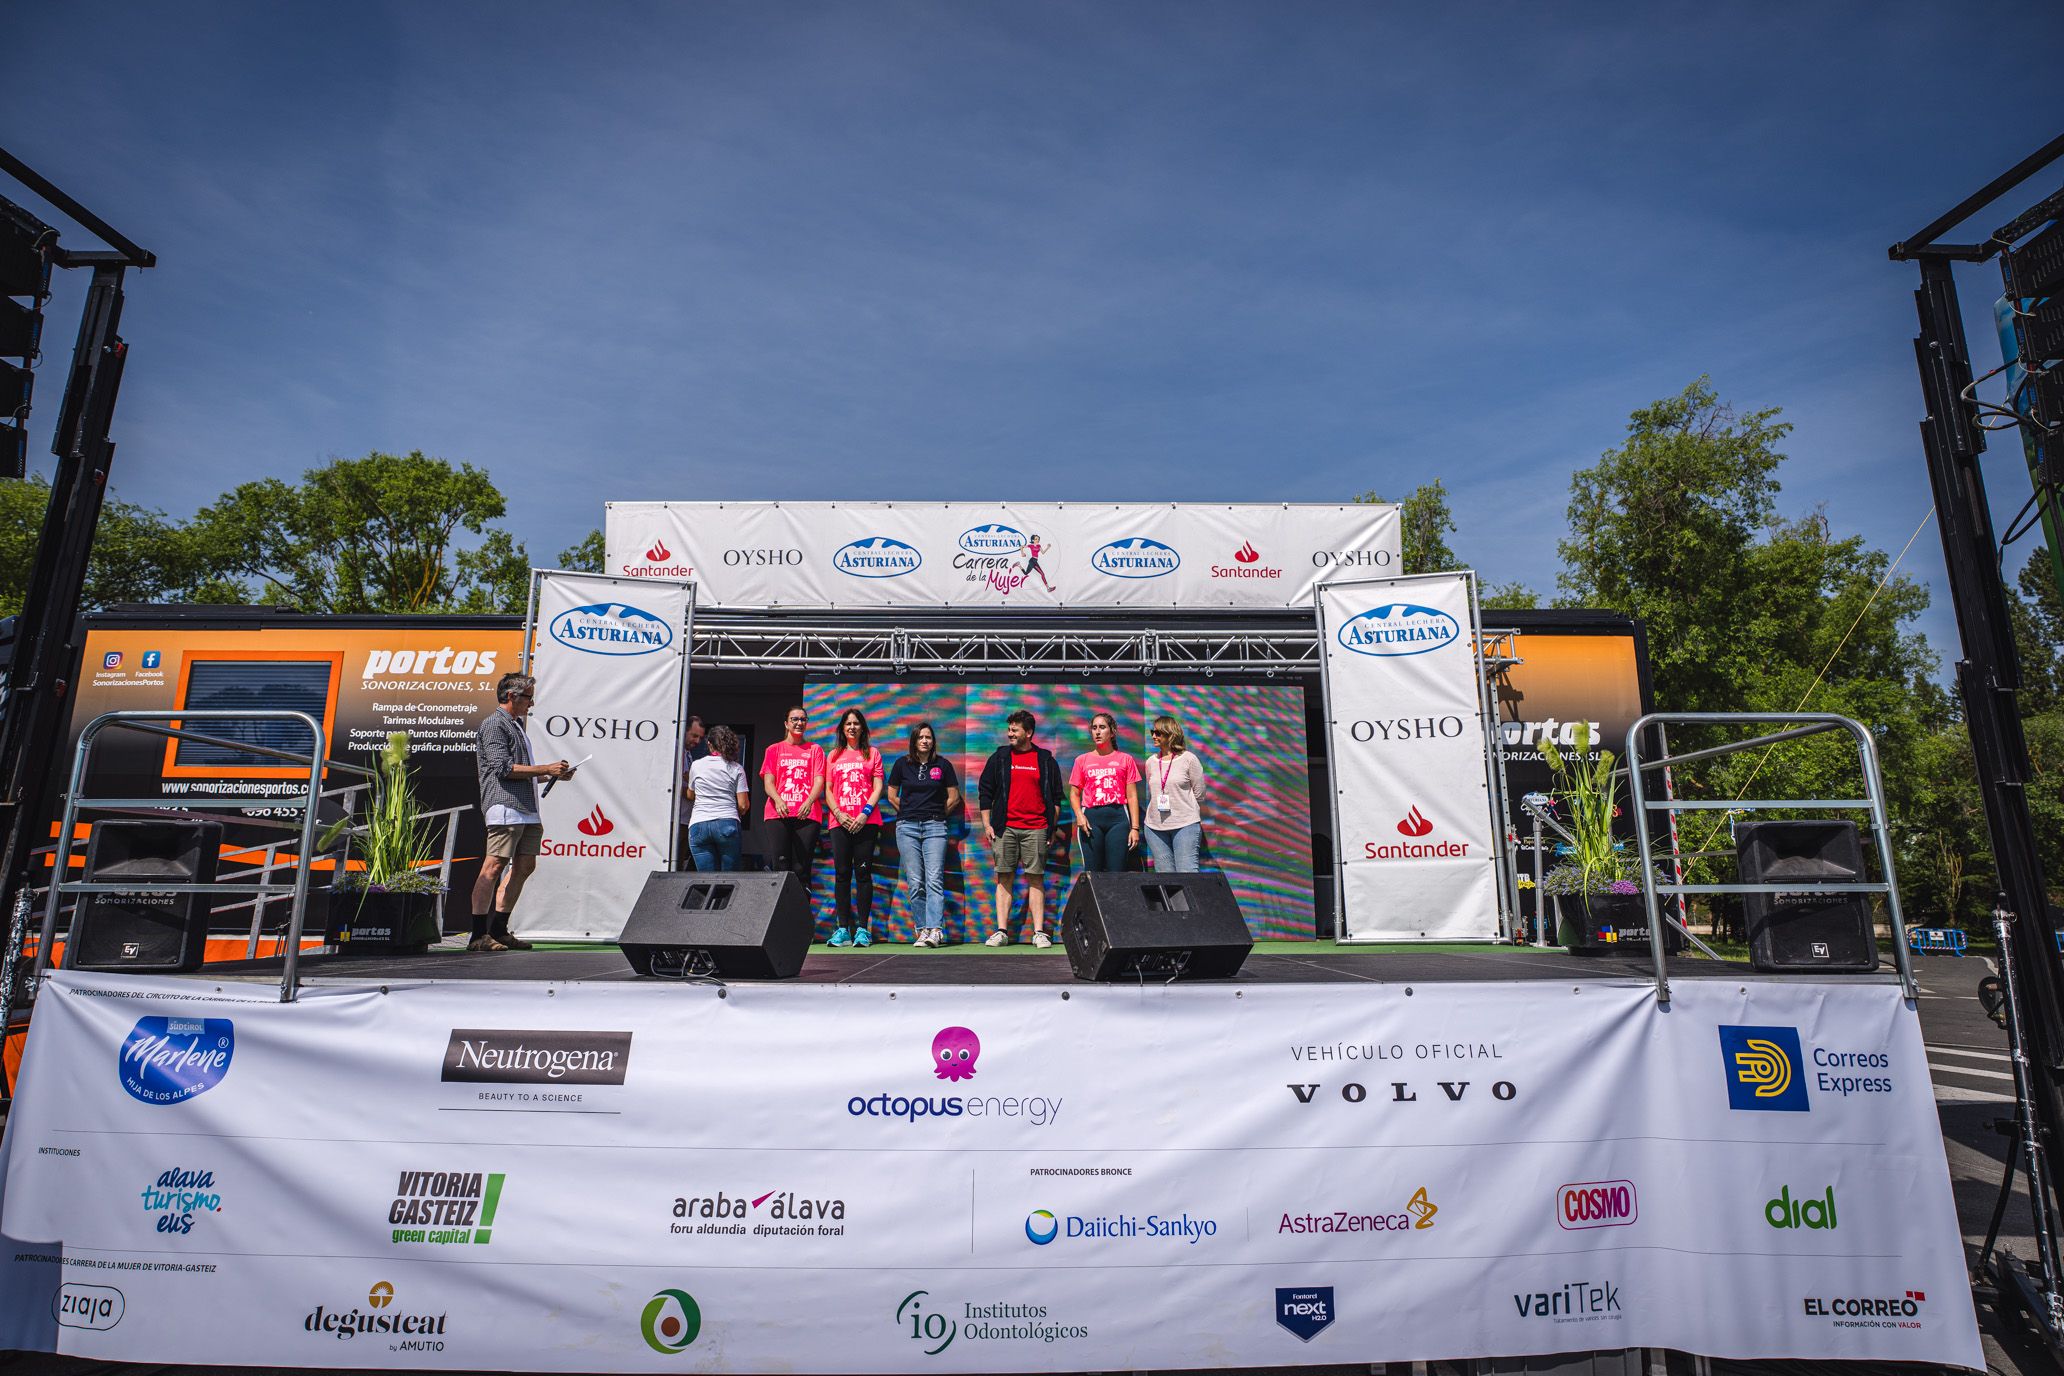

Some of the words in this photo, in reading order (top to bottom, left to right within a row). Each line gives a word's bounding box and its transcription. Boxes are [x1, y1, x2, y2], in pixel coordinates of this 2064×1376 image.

[964, 535, 1021, 547] ASTURIANA
[723, 549, 803, 566] OYSHO
[840, 552, 915, 567] ASTURIANA
[953, 553, 1008, 569] Carrera
[1099, 552, 1173, 568] ASTURIANA
[1312, 550, 1391, 567] OYSHO
[623, 565, 694, 577] Santander
[1211, 565, 1282, 578] Santander
[966, 570, 976, 581] de
[979, 570, 986, 581] la
[985, 568, 1029, 595] Mujer
[580, 618, 618, 627] CENTRAL
[559, 618, 663, 645] ASTURIANA
[1348, 625, 1451, 645] ASTURIANA
[362, 646, 498, 679] portos
[92, 679, 164, 687] SonorizacionesPortos
[361, 680, 474, 692] SONORIZACIONES,
[478, 681, 495, 691] SL.
[372, 702, 403, 714] Rampa
[405, 702, 416, 712] de
[417, 703, 478, 714] Cronometraje
[383, 716, 416, 725] Tarimas
[418, 716, 464, 725] Modulares
[546, 715, 659, 741] OYSHO
[1351, 716, 1463, 742] OYSHO
[350, 729, 385, 739] Soporte
[408, 729, 438, 738] Puntos
[439, 729, 478, 739] Kilométr
[1484, 718, 1600, 746] ortos
[348, 741, 391, 751] Producció
[411, 742, 441, 752] gráfica
[443, 742, 477, 752] publicit
[780, 759, 808, 768] CARRERA
[1589, 752, 1600, 761] SL
[794, 769, 803, 779] DE
[836, 762, 864, 772] CARRERA
[1087, 767, 1116, 777] CARRERA
[850, 771, 859, 782] DE
[1103, 777, 1113, 788] DE
[839, 796, 861, 806] MUJER
[540, 839, 646, 859] Santander
[1365, 843, 1469, 859] Santander
[351, 926, 391, 936] portos
[1618, 927, 1651, 937] porto
[69, 988, 131, 998] PATROCINADORES
[131, 991, 145, 999] DEL
[146, 992, 180, 1000] CIRCUITO
[125, 1035, 224, 1079] Marlene
[456, 1040, 614, 1078] Neutrogena
[1291, 1042, 1403, 1061] VEHÍCULO
[1415, 1043, 1503, 1059] OFICIAL
[1813, 1048, 1889, 1068] Correos
[127, 1076, 142, 1094] HIJA
[143, 1089, 154, 1099] DE
[155, 1091, 170, 1100] LOS
[172, 1082, 205, 1099] ALPES
[1287, 1081, 1517, 1103] VOLVO
[1817, 1072, 1892, 1096] Express
[479, 1092, 514, 1101] BEAUTY
[518, 1093, 530, 1101] TO
[542, 1094, 583, 1102] SCIENCE
[38, 1147, 81, 1157] INSTITUCIONES
[157, 1167, 215, 1189] alava
[1030, 1168, 1099, 1176] PATROCINADORES
[1100, 1168, 1132, 1176] BRONCE
[397, 1171, 483, 1198] VITORIA
[388, 1199, 478, 1226] GASTEIZ
[673, 1192, 747, 1218] araba
[770, 1192, 845, 1220] álava
[1564, 1186, 1630, 1222] COSMO
[1765, 1184, 1837, 1230] dial
[157, 1213, 195, 1234] eus
[670, 1223, 693, 1234] foru
[697, 1223, 746, 1235] aldundia
[753, 1224, 814, 1237] diputación
[818, 1224, 844, 1236] foral
[1067, 1214, 1217, 1244] Daiichi-Sankyo
[1279, 1212, 1410, 1234] AstraZeneca
[392, 1229, 426, 1244] green
[428, 1228, 472, 1245] capital
[14, 1254, 69, 1265] PATROCINADORES
[70, 1258, 96, 1268] CARRERA
[97, 1261, 107, 1269] DE
[107, 1261, 116, 1269] LA
[117, 1262, 141, 1271] MUJER
[142, 1263, 152, 1271] DE
[153, 1263, 217, 1273] VITORIA-GASTEIZ
[1284, 1300, 1326, 1315] next
[1514, 1281, 1621, 1317] variTek
[1804, 1299, 1829, 1315] EL
[1832, 1298, 1918, 1317] CORREO
[965, 1302, 1047, 1319] Institutos
[305, 1305, 448, 1341] degusteat
[1833, 1320, 1880, 1328] INFORMACIÓN
[964, 1322, 1088, 1344] Odontológicos
[389, 1344, 398, 1352] by
[400, 1341, 444, 1352] AMUTIO
